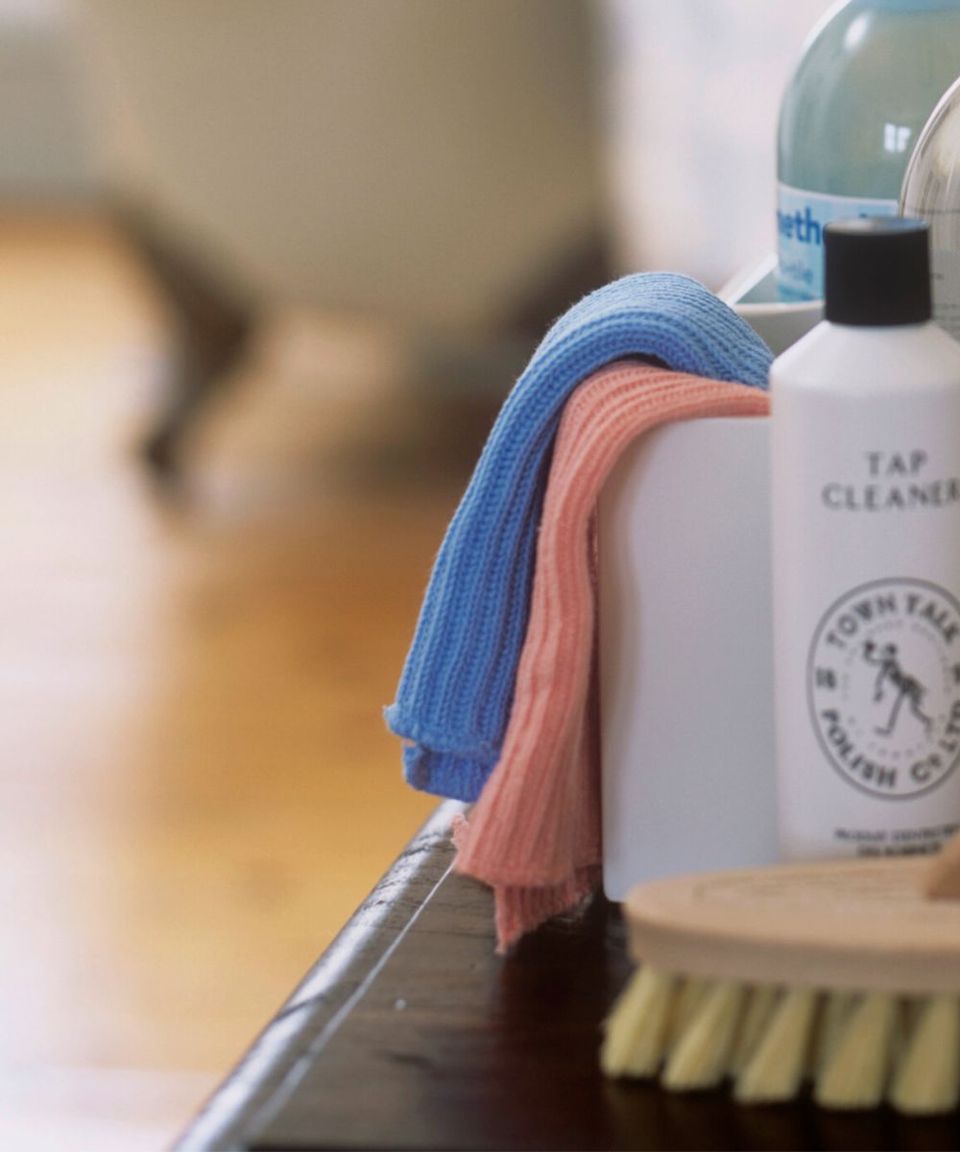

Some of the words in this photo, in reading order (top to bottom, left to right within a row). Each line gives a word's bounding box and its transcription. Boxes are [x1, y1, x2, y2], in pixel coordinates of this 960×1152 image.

[865, 451, 928, 477] TAP
[826, 593, 896, 648] TOWN
[905, 594, 960, 644] TALK
[821, 708, 897, 788] POLISH
